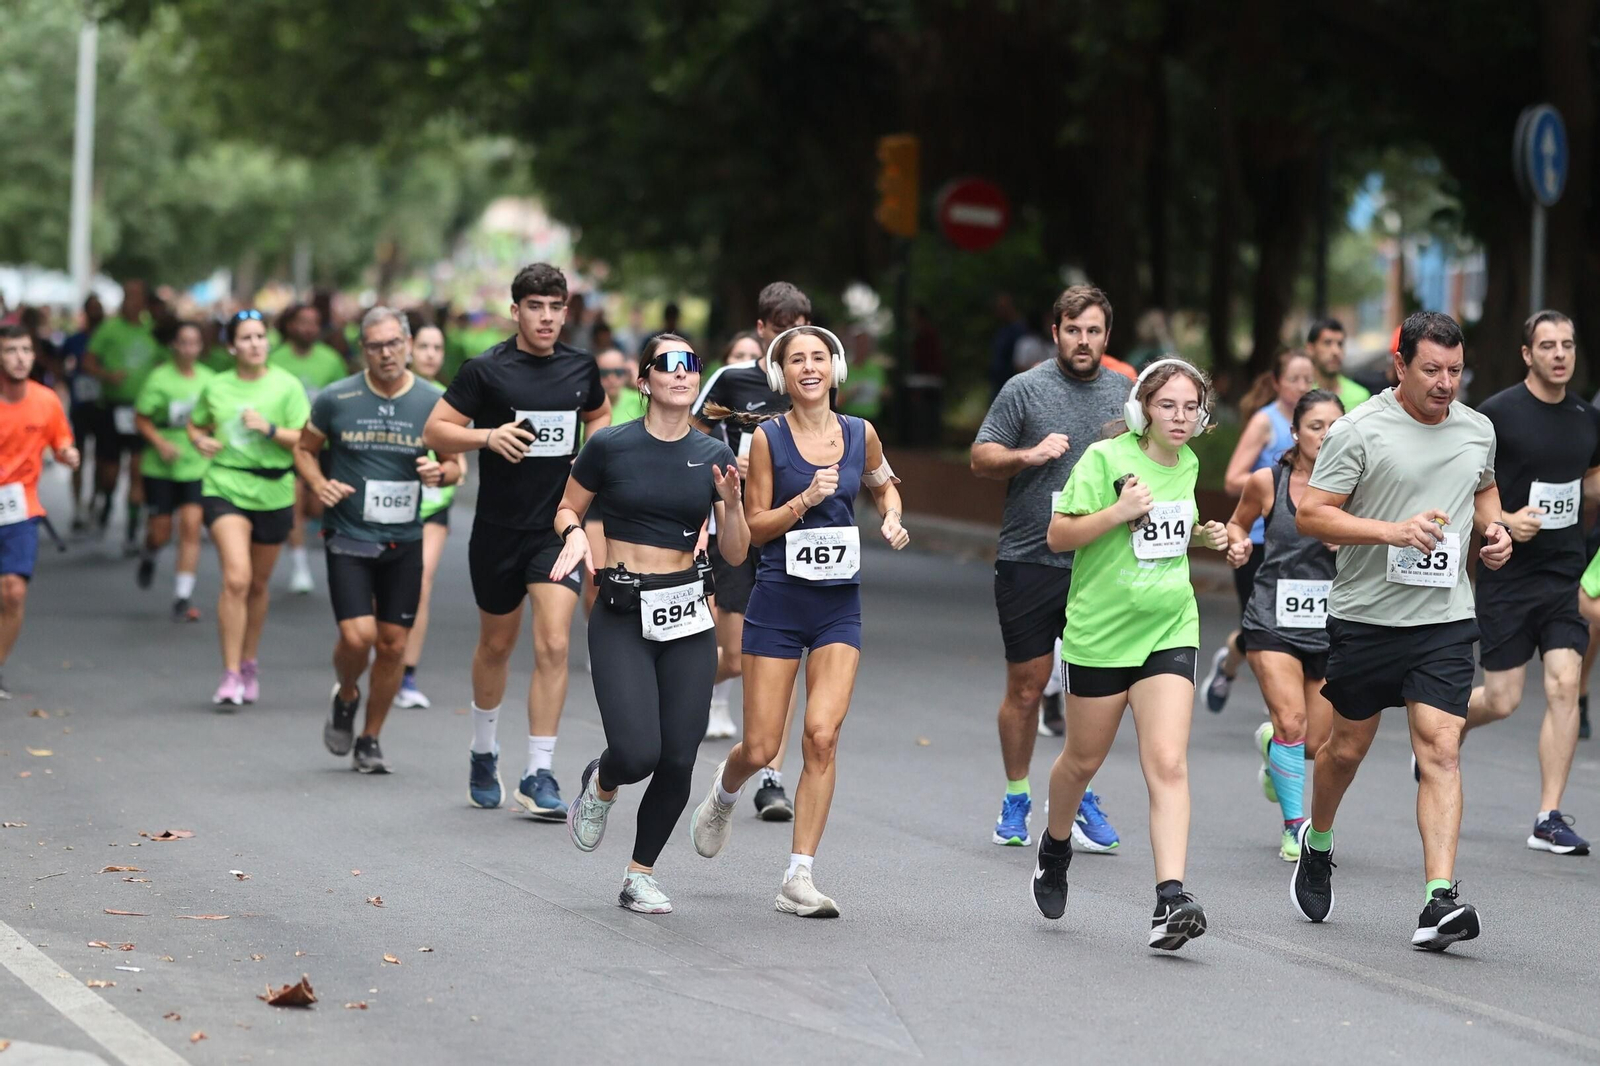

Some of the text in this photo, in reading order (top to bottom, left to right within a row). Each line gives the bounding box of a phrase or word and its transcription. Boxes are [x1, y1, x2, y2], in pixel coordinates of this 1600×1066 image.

[341, 430, 424, 448] MARBELLA
[538, 427, 564, 442] 63
[372, 496, 412, 509] 1062
[1539, 497, 1574, 515] 595
[1143, 520, 1186, 542] 814
[796, 545, 847, 565] 467
[653, 601, 697, 626] 694
[1285, 596, 1328, 613] 941
